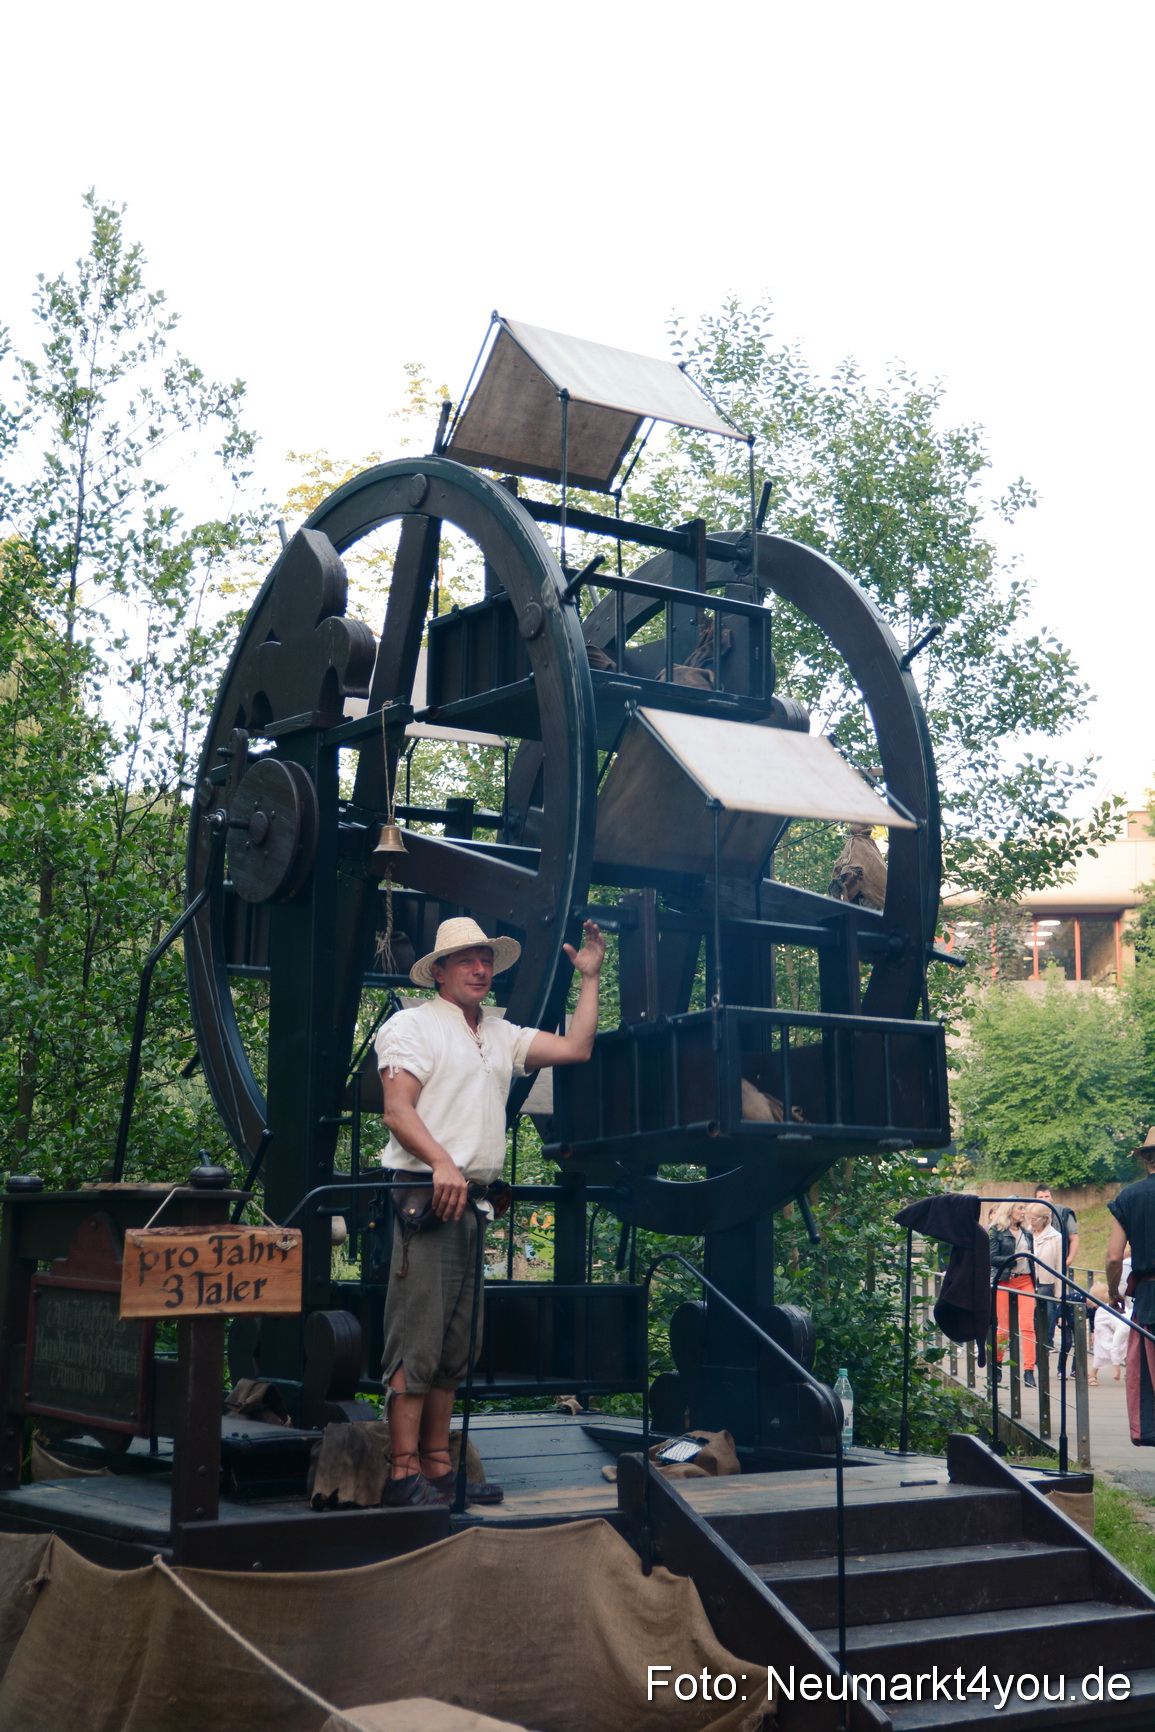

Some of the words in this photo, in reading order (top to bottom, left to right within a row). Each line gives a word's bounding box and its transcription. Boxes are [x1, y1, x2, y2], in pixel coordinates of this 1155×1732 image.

[139, 1247, 199, 1286] pro
[208, 1234, 294, 1268] Fahrt
[163, 1274, 184, 1308] 3
[190, 1271, 268, 1309] Taler
